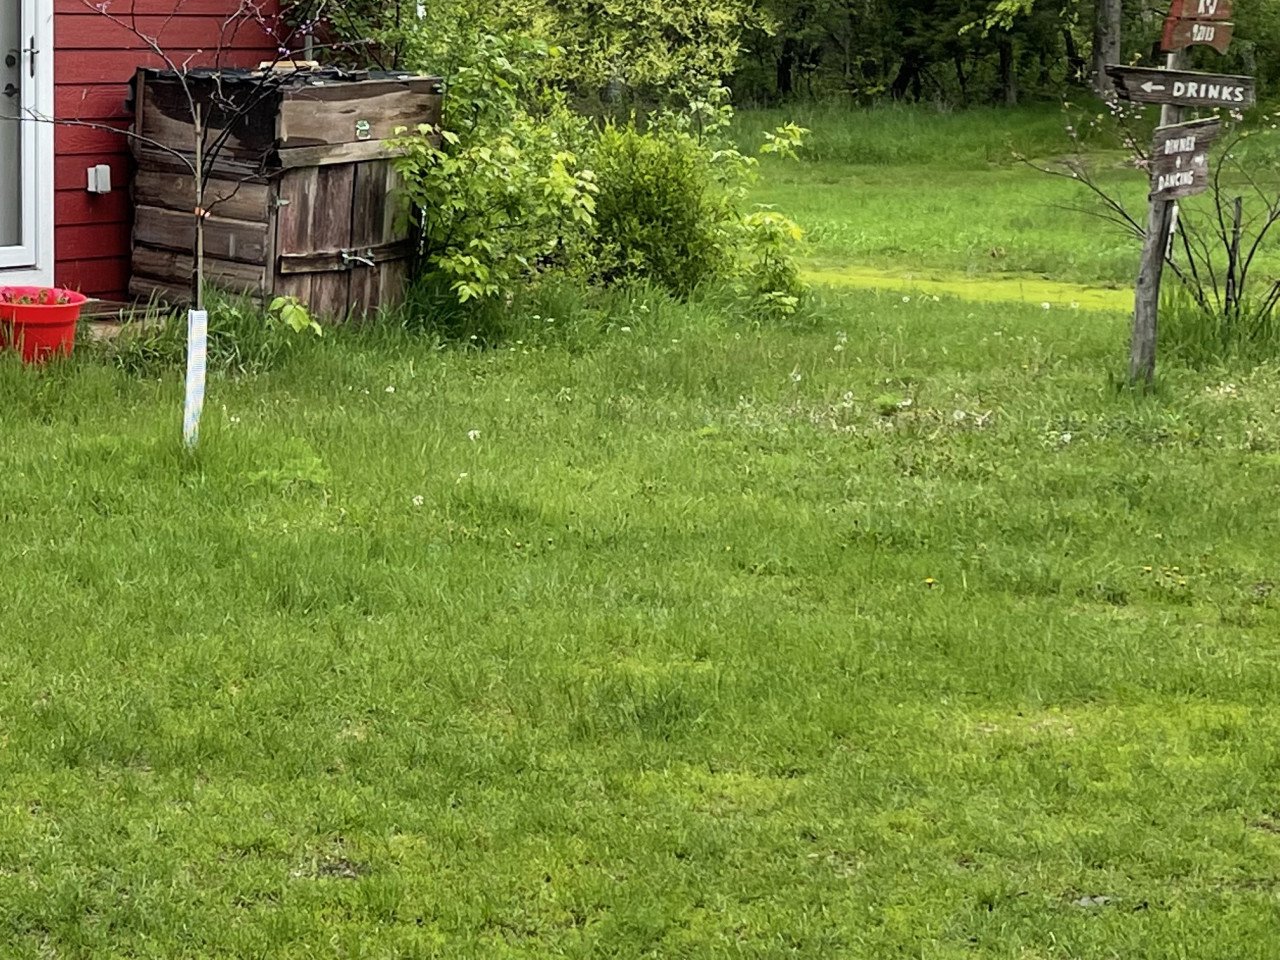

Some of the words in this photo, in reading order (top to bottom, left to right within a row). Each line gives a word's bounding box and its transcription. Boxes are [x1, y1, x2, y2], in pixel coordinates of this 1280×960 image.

[1173, 81, 1244, 102] DRINKS
[1164, 136, 1196, 155] DINNER
[1157, 170, 1194, 191] DANCING
